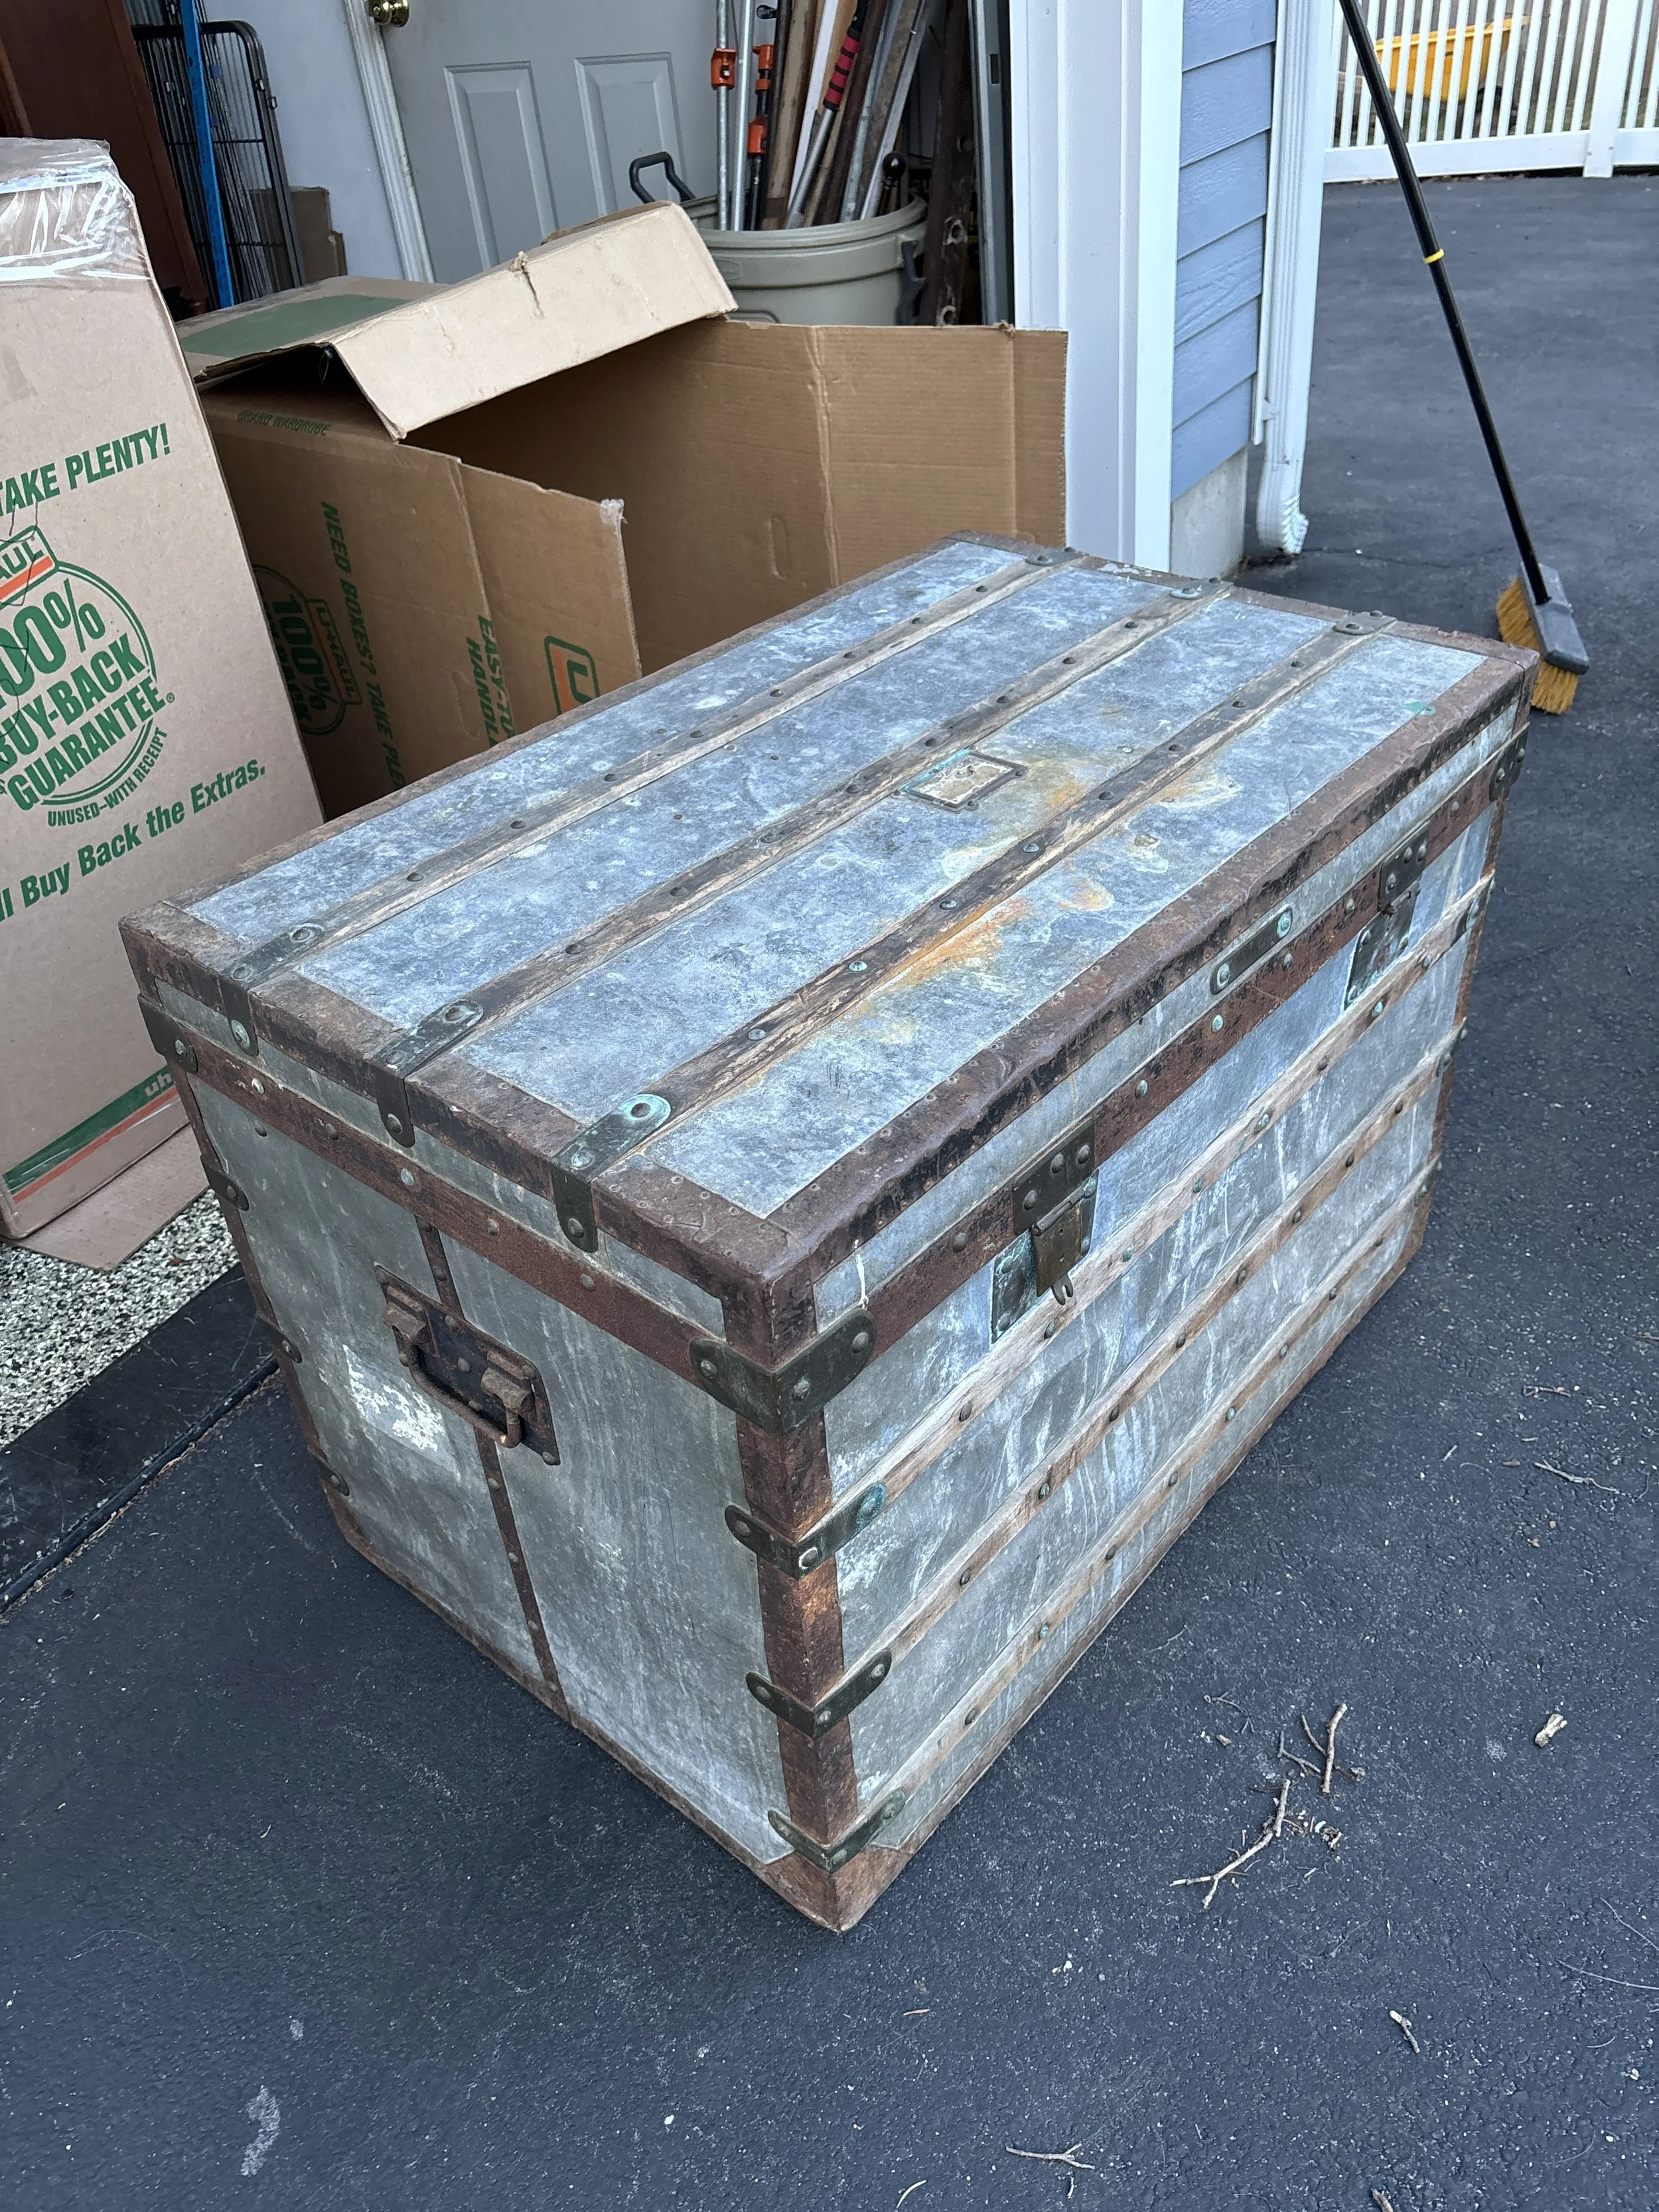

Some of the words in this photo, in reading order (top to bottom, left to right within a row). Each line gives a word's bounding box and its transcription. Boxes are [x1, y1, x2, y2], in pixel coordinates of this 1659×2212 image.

[64, 422, 171, 490] PLENTY!
[238, 409, 273, 426] GRAND
[273, 415, 331, 436] WARDROBE
[0, 578, 106, 709] 00%
[271, 594, 338, 711] 100%
[321, 501, 352, 573] NEED
[339, 578, 377, 676] BOXES?
[366, 681, 394, 740] TAKE
[381, 741, 406, 790] PLE
[132, 726, 168, 784] RECEIPT
[19, 861, 70, 908] Buy
[77, 822, 143, 877] Back
[145, 800, 185, 838] the
[190, 759, 266, 814] Extras.
